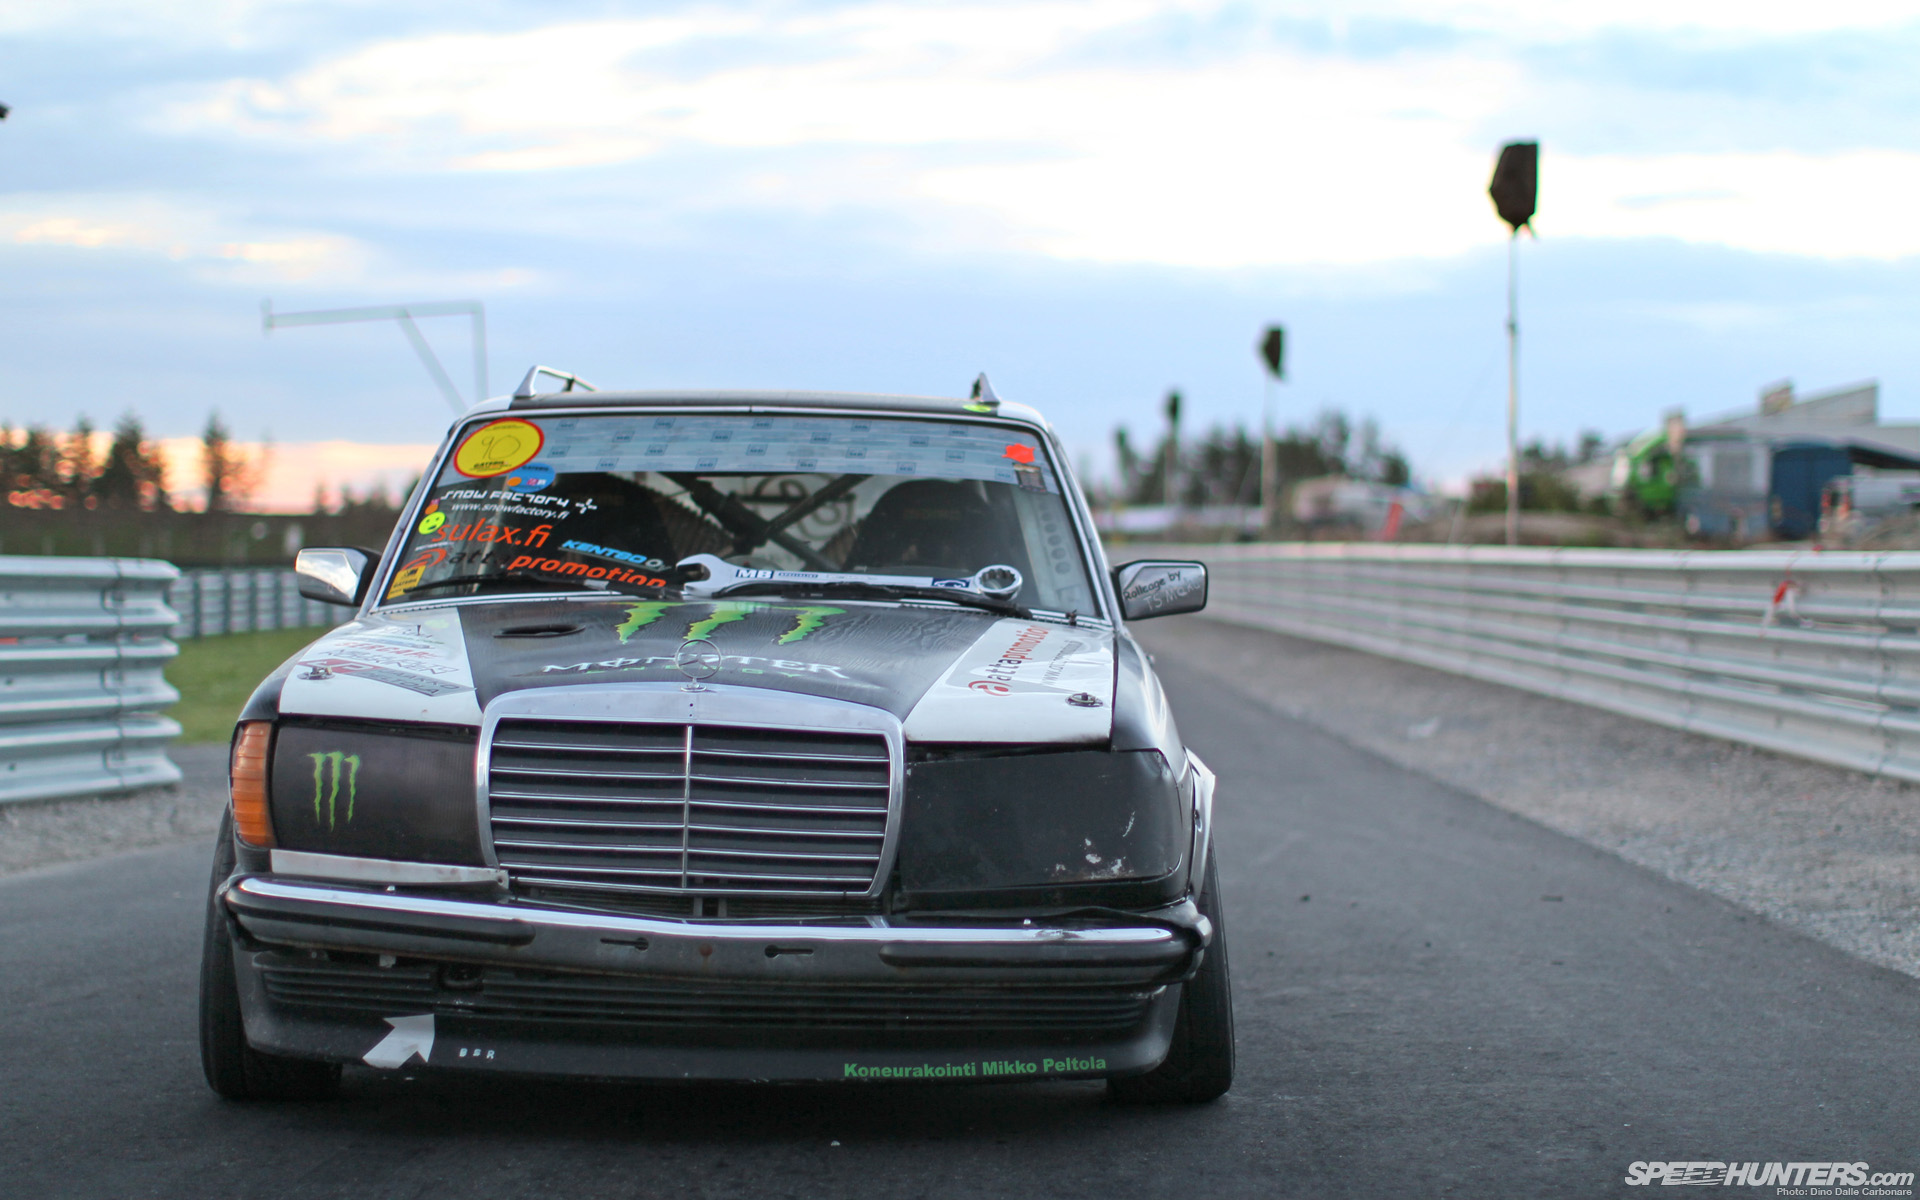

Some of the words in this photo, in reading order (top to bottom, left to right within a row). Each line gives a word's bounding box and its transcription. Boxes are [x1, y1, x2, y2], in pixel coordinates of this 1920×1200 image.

[451, 502, 570, 519] www.snowfactory.fi
[432, 517, 553, 548] sulax.fi
[507, 555, 667, 587] promotion
[738, 569, 772, 578] MB
[1123, 578, 1166, 600] Rollcage
[844, 1062, 976, 1078] Koneurakointi
[982, 1060, 1037, 1075] Mikko
[1043, 1056, 1107, 1073] Peltola
